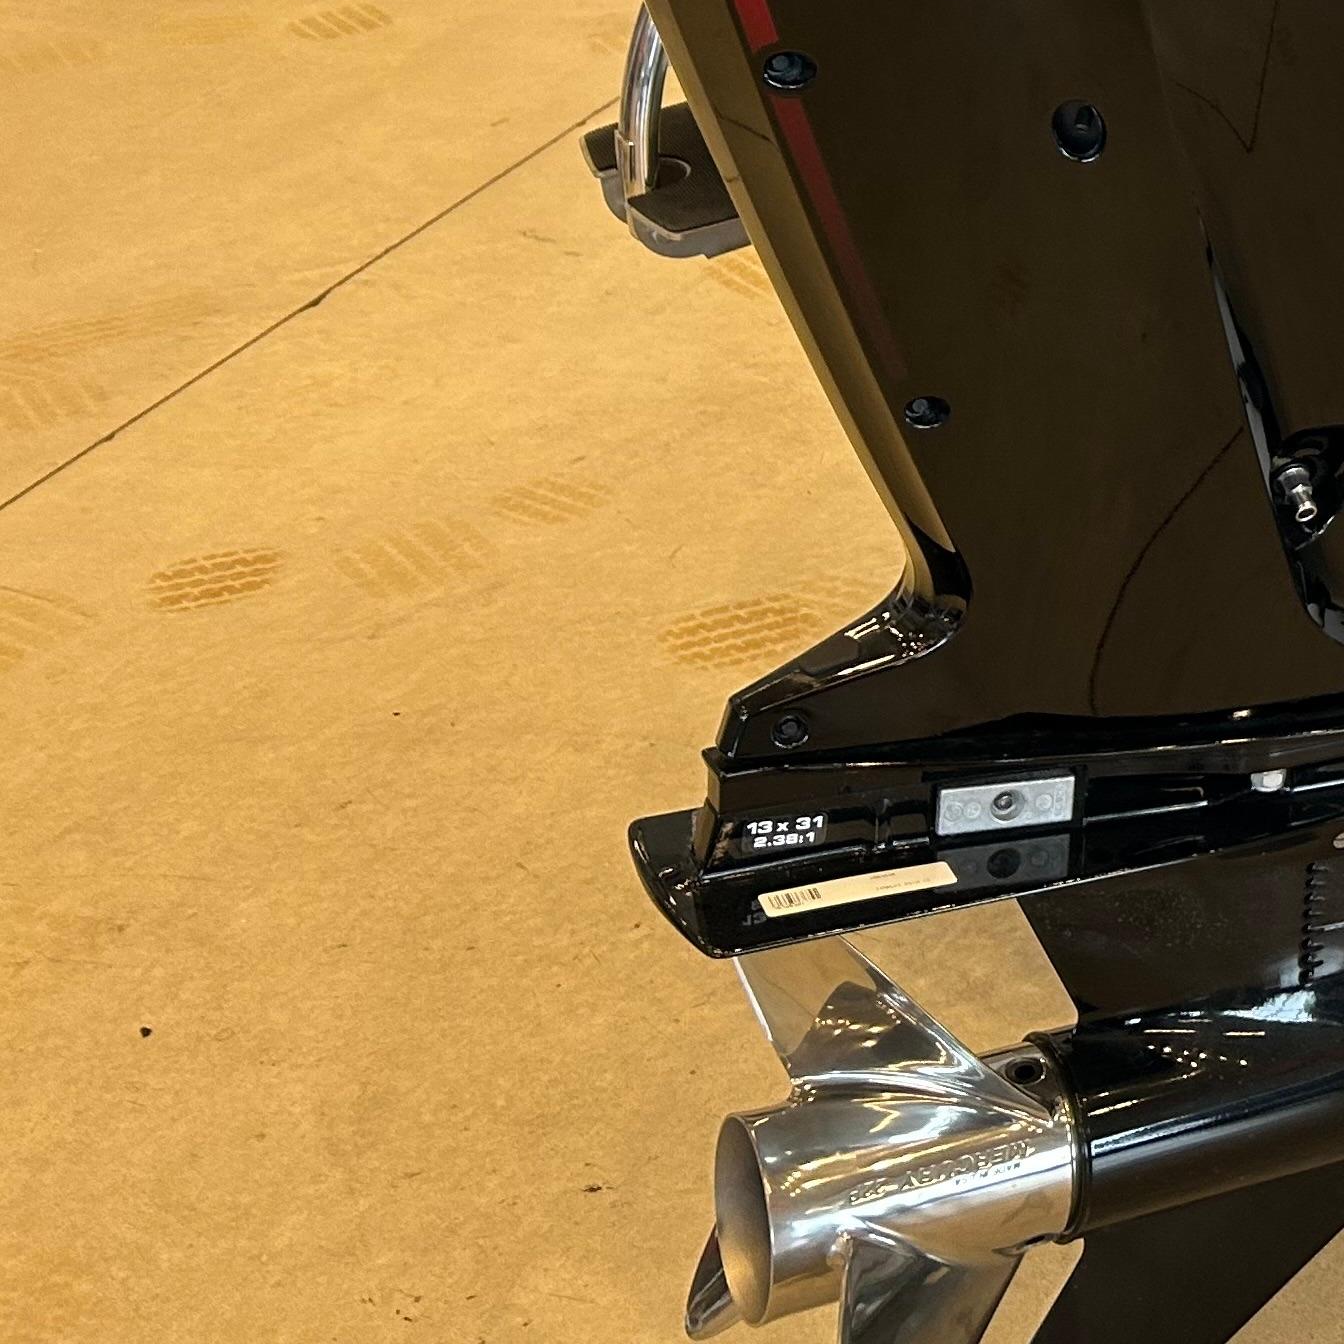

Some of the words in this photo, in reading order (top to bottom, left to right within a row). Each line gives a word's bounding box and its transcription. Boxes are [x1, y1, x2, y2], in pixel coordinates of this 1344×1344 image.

[747, 820, 773, 835] 13
[776, 821, 789, 833] x
[795, 816, 824, 830] 31
[753, 831, 815, 848] 2.38:1
